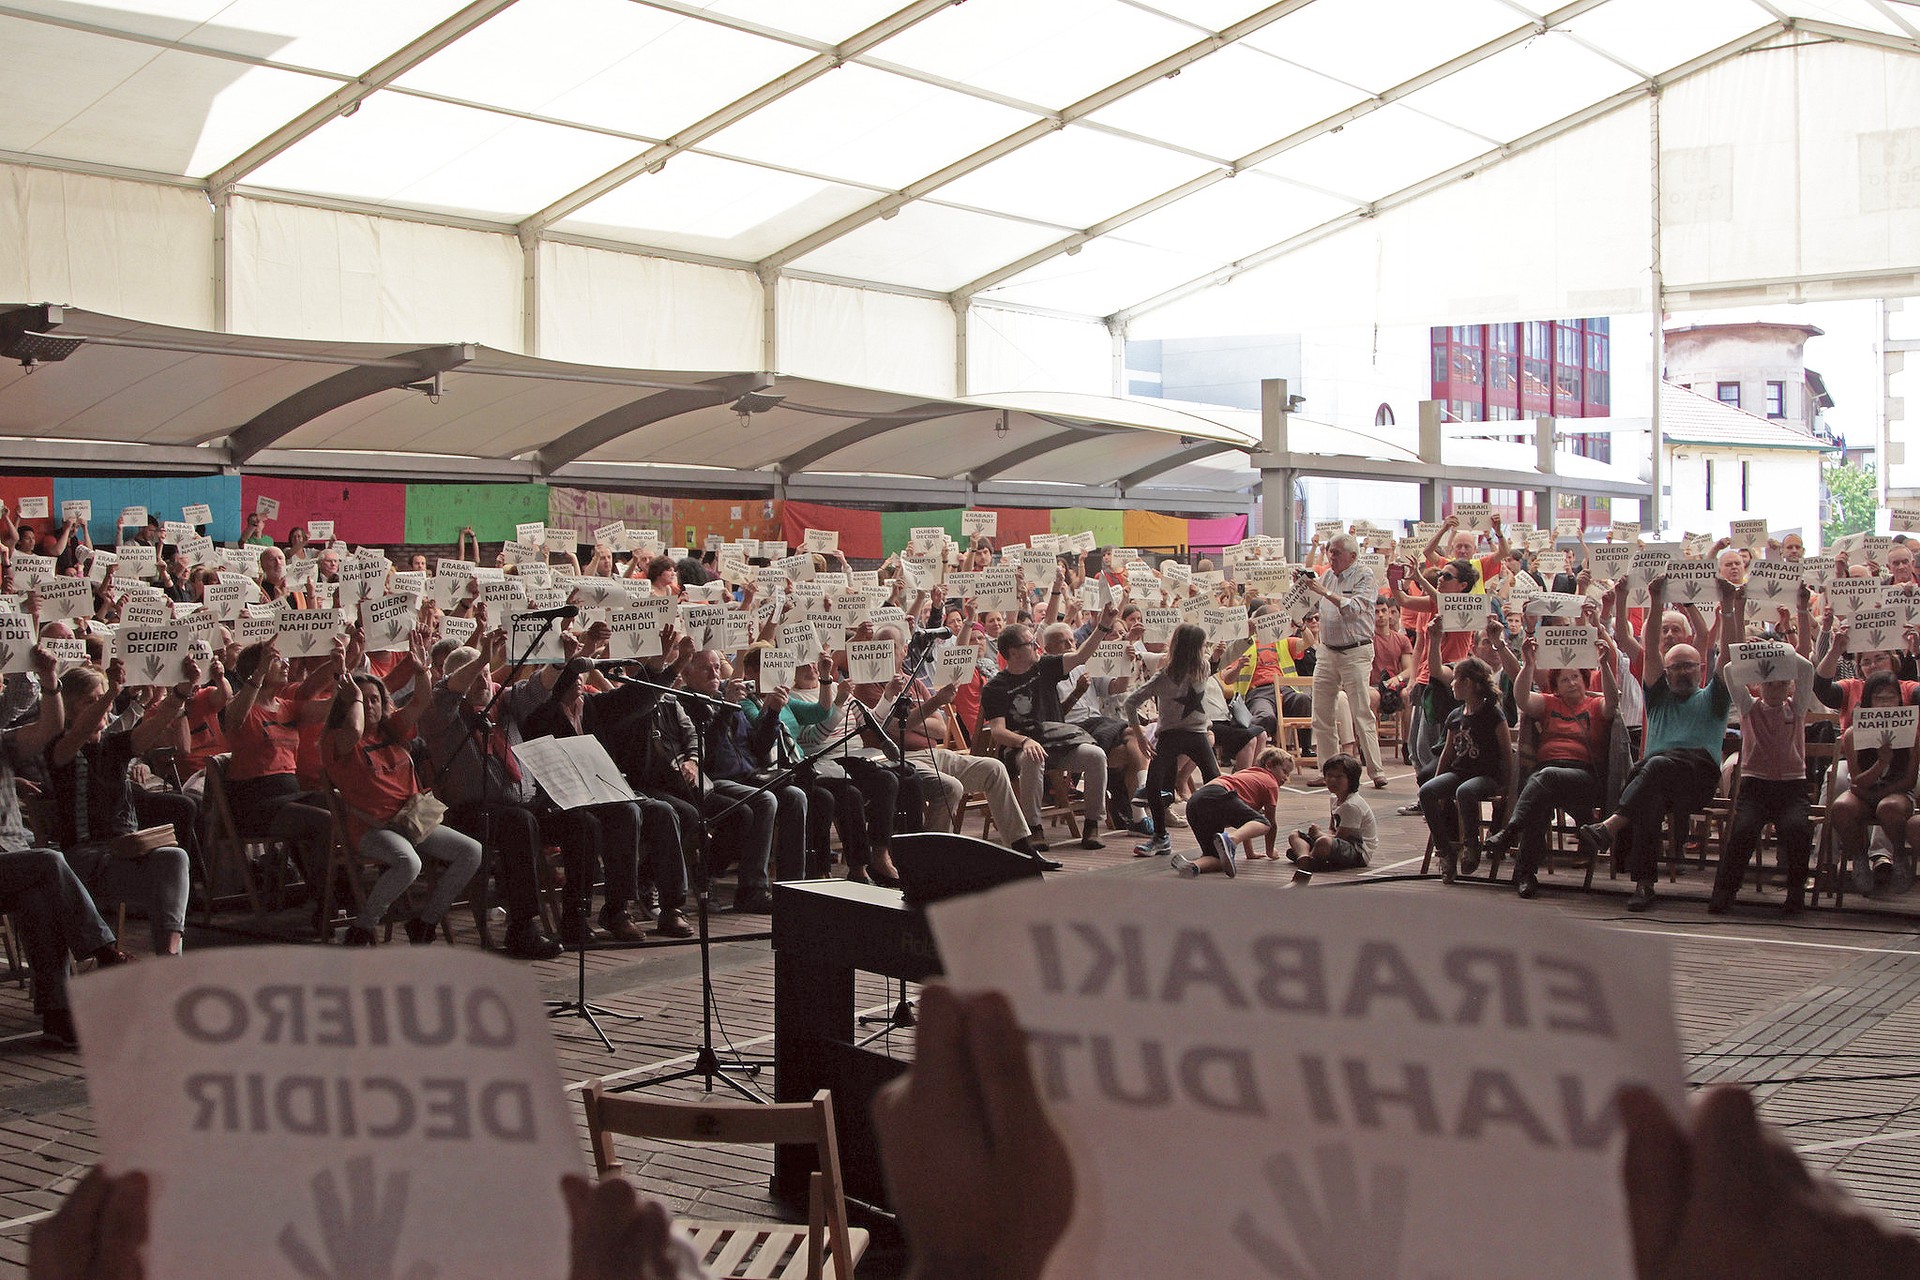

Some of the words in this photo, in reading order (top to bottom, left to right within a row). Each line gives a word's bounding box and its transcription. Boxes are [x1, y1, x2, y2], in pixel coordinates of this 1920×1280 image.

[182, 540, 208, 549] ERABAKI
[344, 562, 380, 571] ERABAKI
[1754, 562, 1799, 573] ERABAKI
[1750, 570, 1776, 579] NAHI
[41, 581, 84, 592] ERABAKI
[41, 592, 65, 600] NAHI
[68, 589, 88, 597] DUT
[370, 595, 408, 612] QUIERO
[632, 599, 669, 607] QUIERO
[1183, 595, 1208, 607] QUIERO
[129, 607, 163, 616] QUIERO
[372, 605, 408, 623] DECIDIR
[689, 609, 724, 618] ERABAKI
[1855, 611, 1895, 621] QUIERO
[128, 615, 162, 623] DECIDIR
[282, 613, 332, 621] ERABAKI
[612, 612, 653, 622] ERABAKI
[1257, 612, 1289, 624] ERABAKI
[196, 622, 215, 631] DUT
[611, 624, 635, 632] NAHI
[1258, 621, 1276, 630] NAHI
[1277, 617, 1291, 626] DUT
[1855, 620, 1896, 629] DECIDIR
[7, 631, 30, 639] DUT
[127, 631, 178, 641] QUIERO
[785, 634, 813, 644] DECIDIR
[128, 643, 177, 653] DECIDIR
[1740, 650, 1785, 660] DECIDIR
[1860, 710, 1912, 719] ERABAKI
[1858, 720, 1888, 729] NAHI
